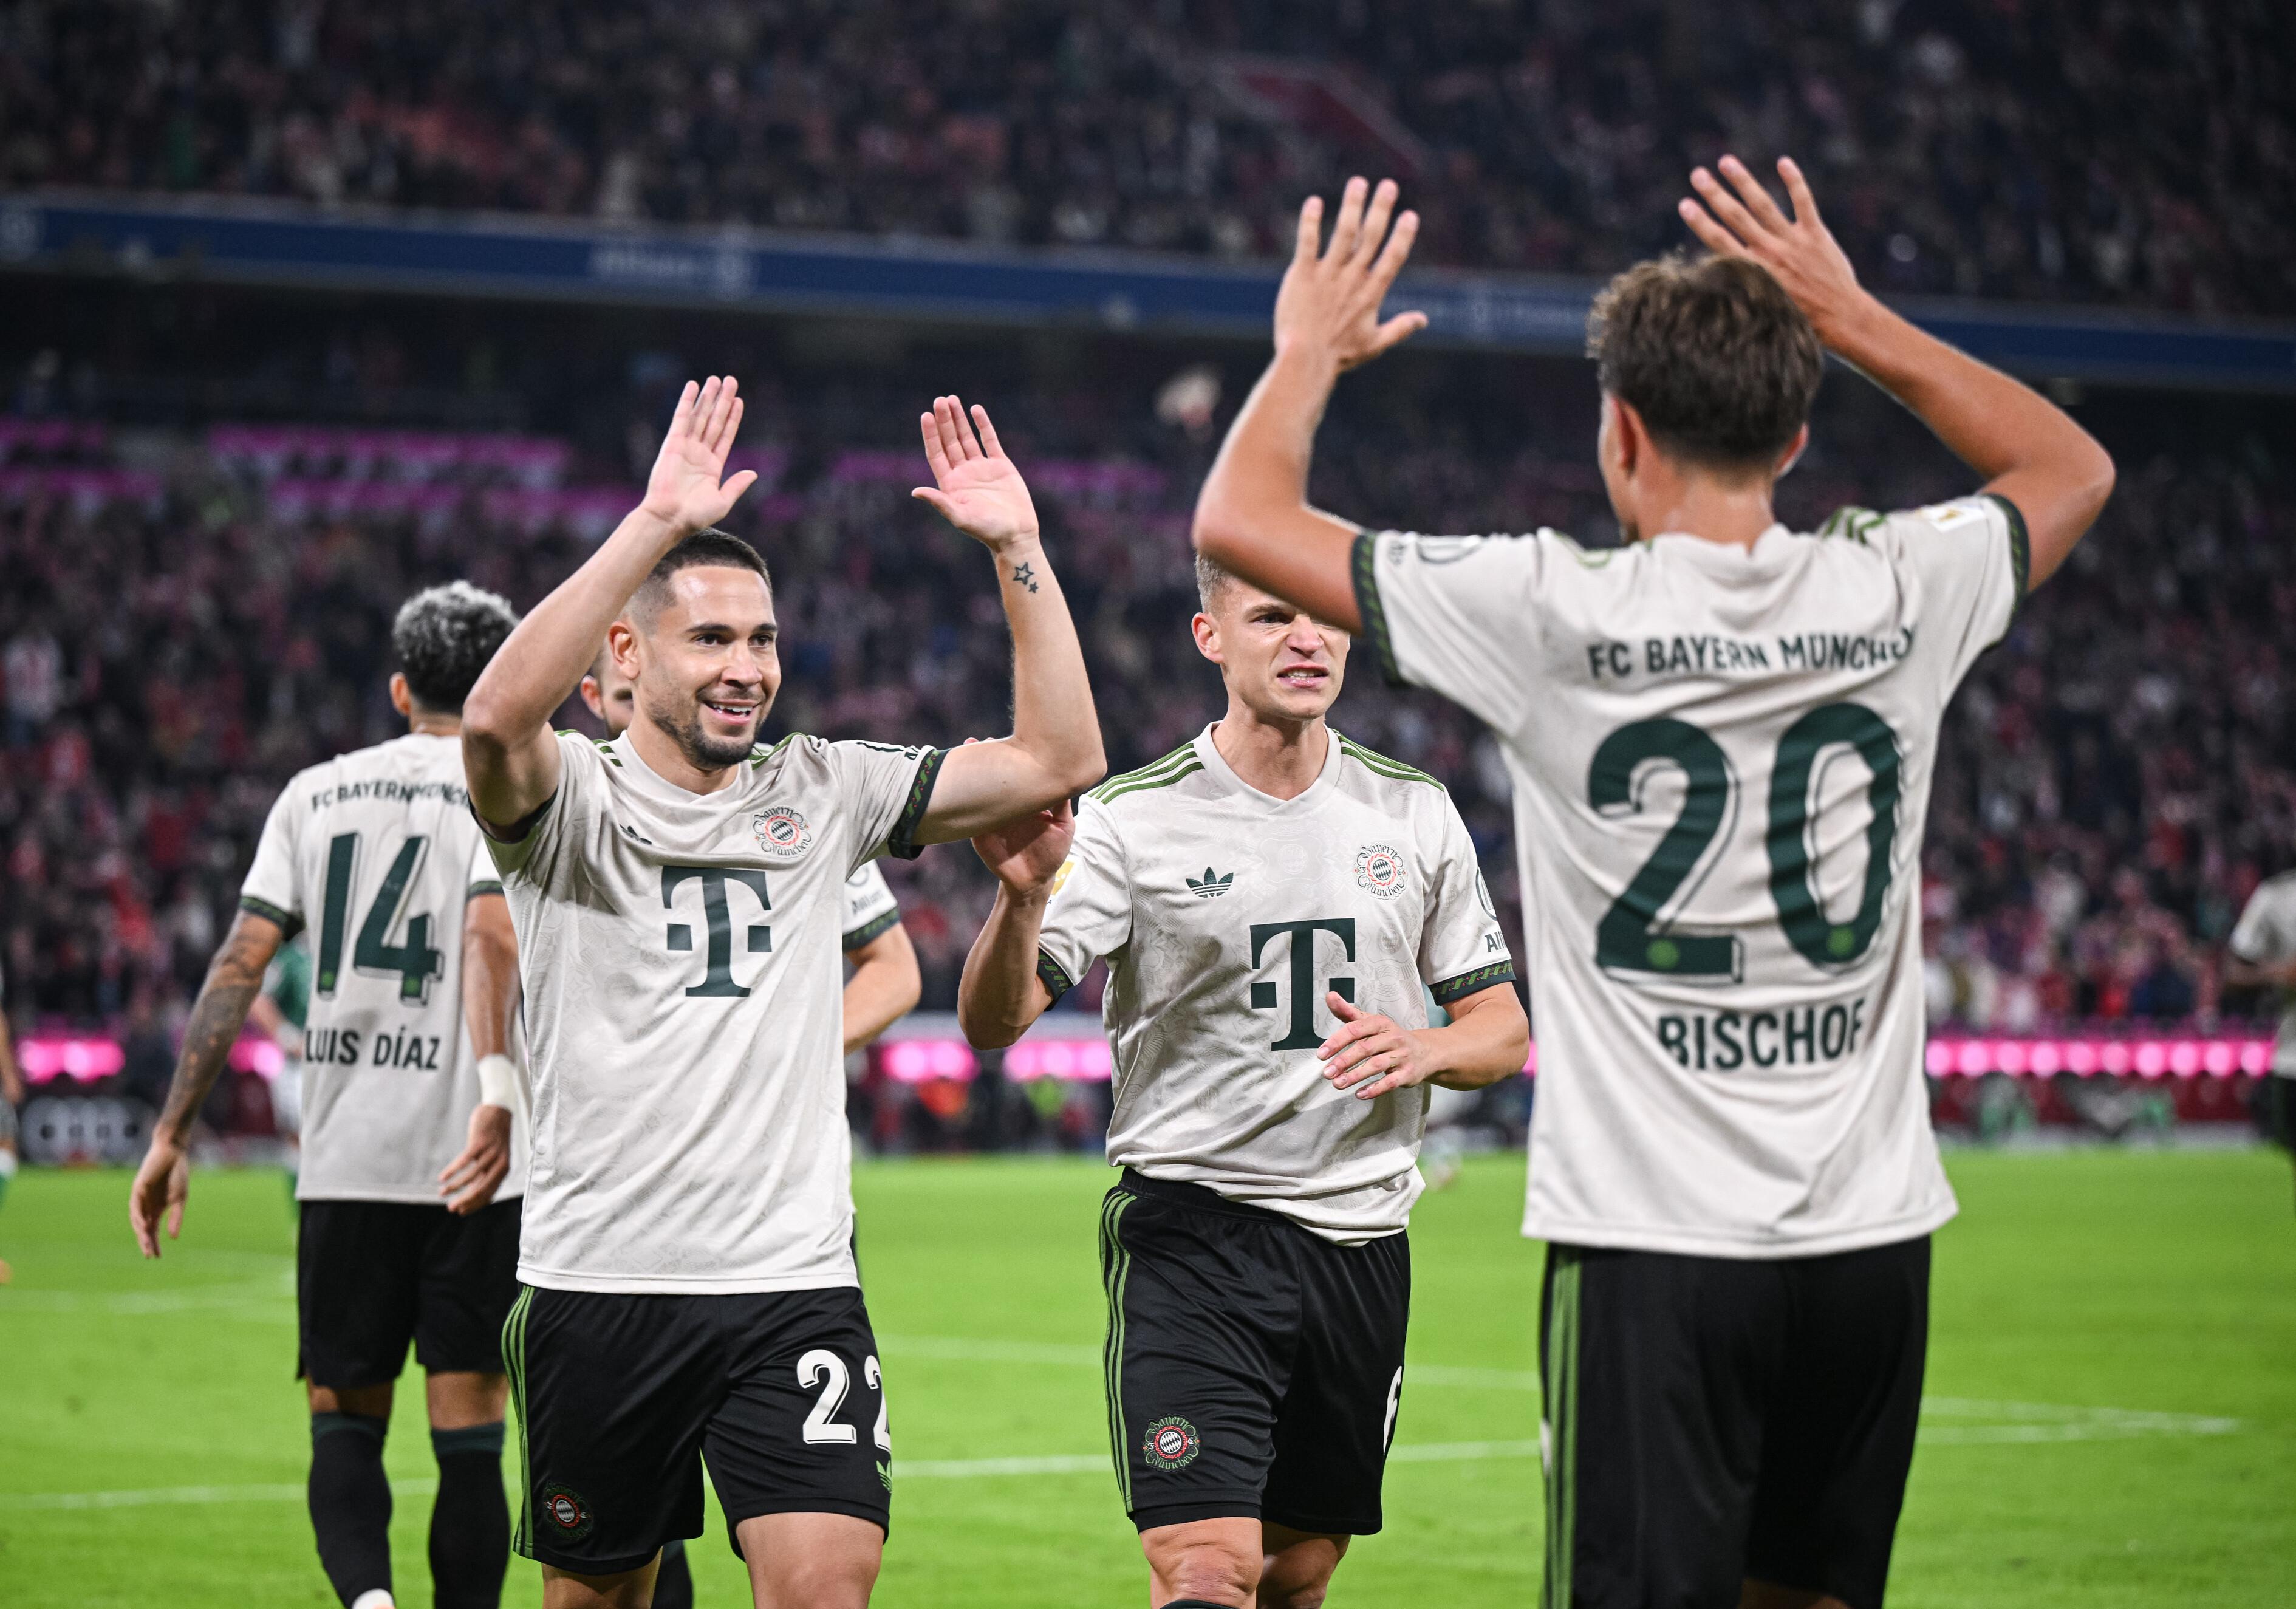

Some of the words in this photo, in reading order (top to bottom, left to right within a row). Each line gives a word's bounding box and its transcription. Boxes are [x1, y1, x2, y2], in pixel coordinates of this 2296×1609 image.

[1587, 640, 1632, 679] FC
[1645, 635, 1769, 677] BAYERN
[311, 789, 333, 811] FC
[337, 779, 414, 804] BAYERN
[1587, 702, 1904, 987] 20
[317, 829, 445, 1006] 14
[661, 865, 772, 997] T
[1250, 918, 1356, 1051] T
[306, 1028, 360, 1067] LUIS
[372, 1024, 440, 1071] DÍAZ
[1658, 997, 1865, 1071] BISCHOF
[797, 1349, 892, 1455] 22
[1145, 1416, 1196, 1443] Bayern
